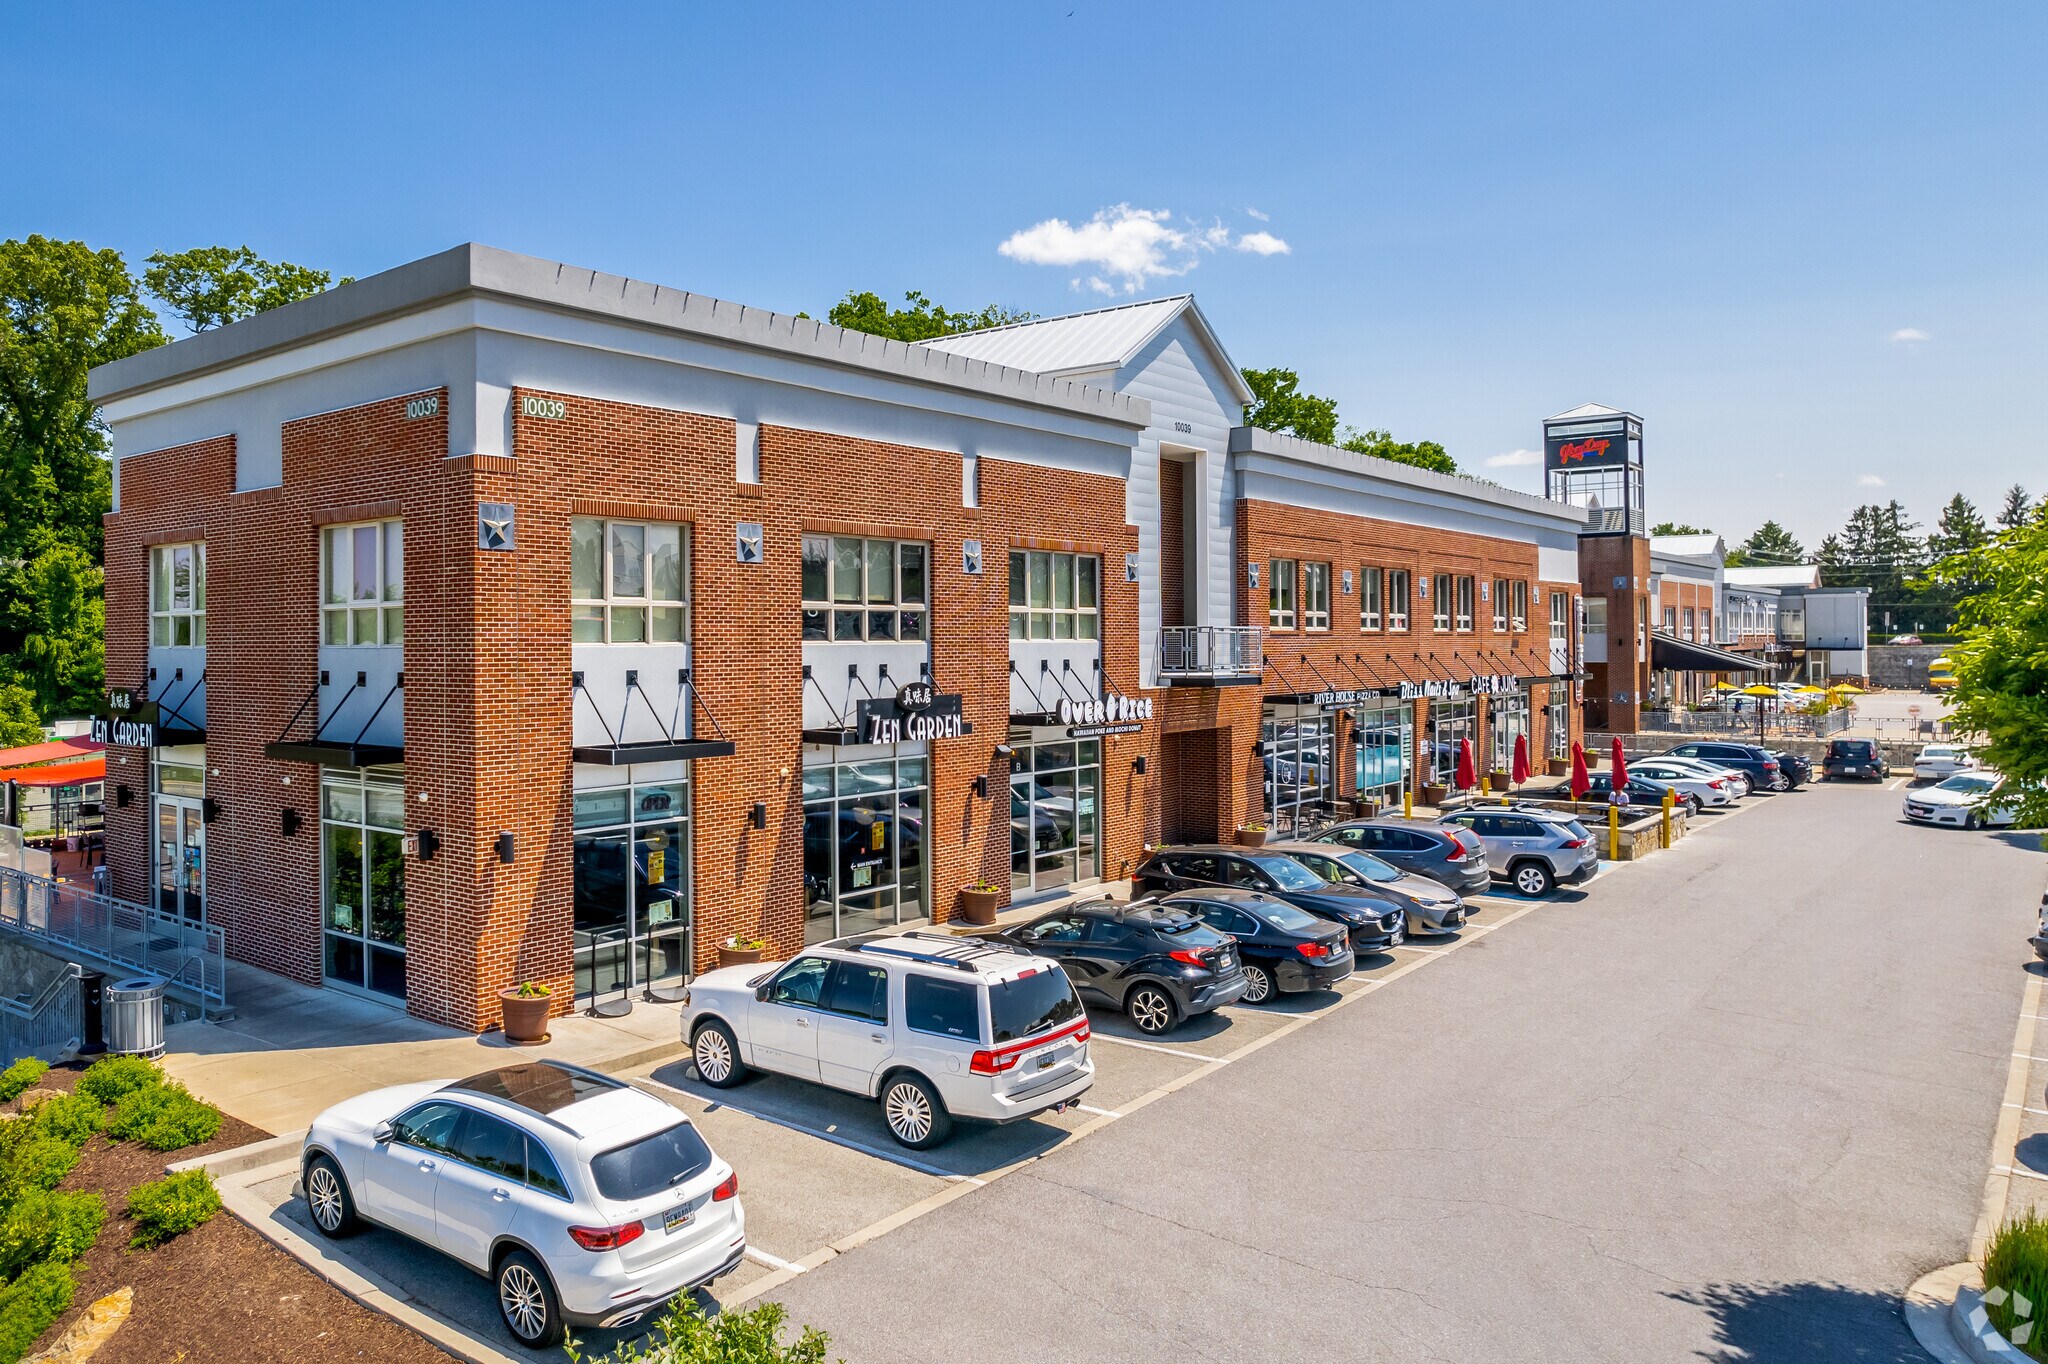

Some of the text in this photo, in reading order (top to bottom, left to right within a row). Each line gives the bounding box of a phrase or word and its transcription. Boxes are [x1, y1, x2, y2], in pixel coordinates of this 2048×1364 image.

[406, 397, 438, 419] 10039
[523, 397, 564, 418] 10039
[1175, 422, 1192, 433] 10039
[1442, 680, 1449, 697] &
[1471, 675, 1518, 695] CAFE JUNE
[1314, 692, 1335, 705] RIVER
[1335, 690, 1356, 703] HOUSE
[1060, 695, 1153, 725] OVER RICE
[1016, 762, 1021, 771] B
[642, 796, 670, 812] OPEN
